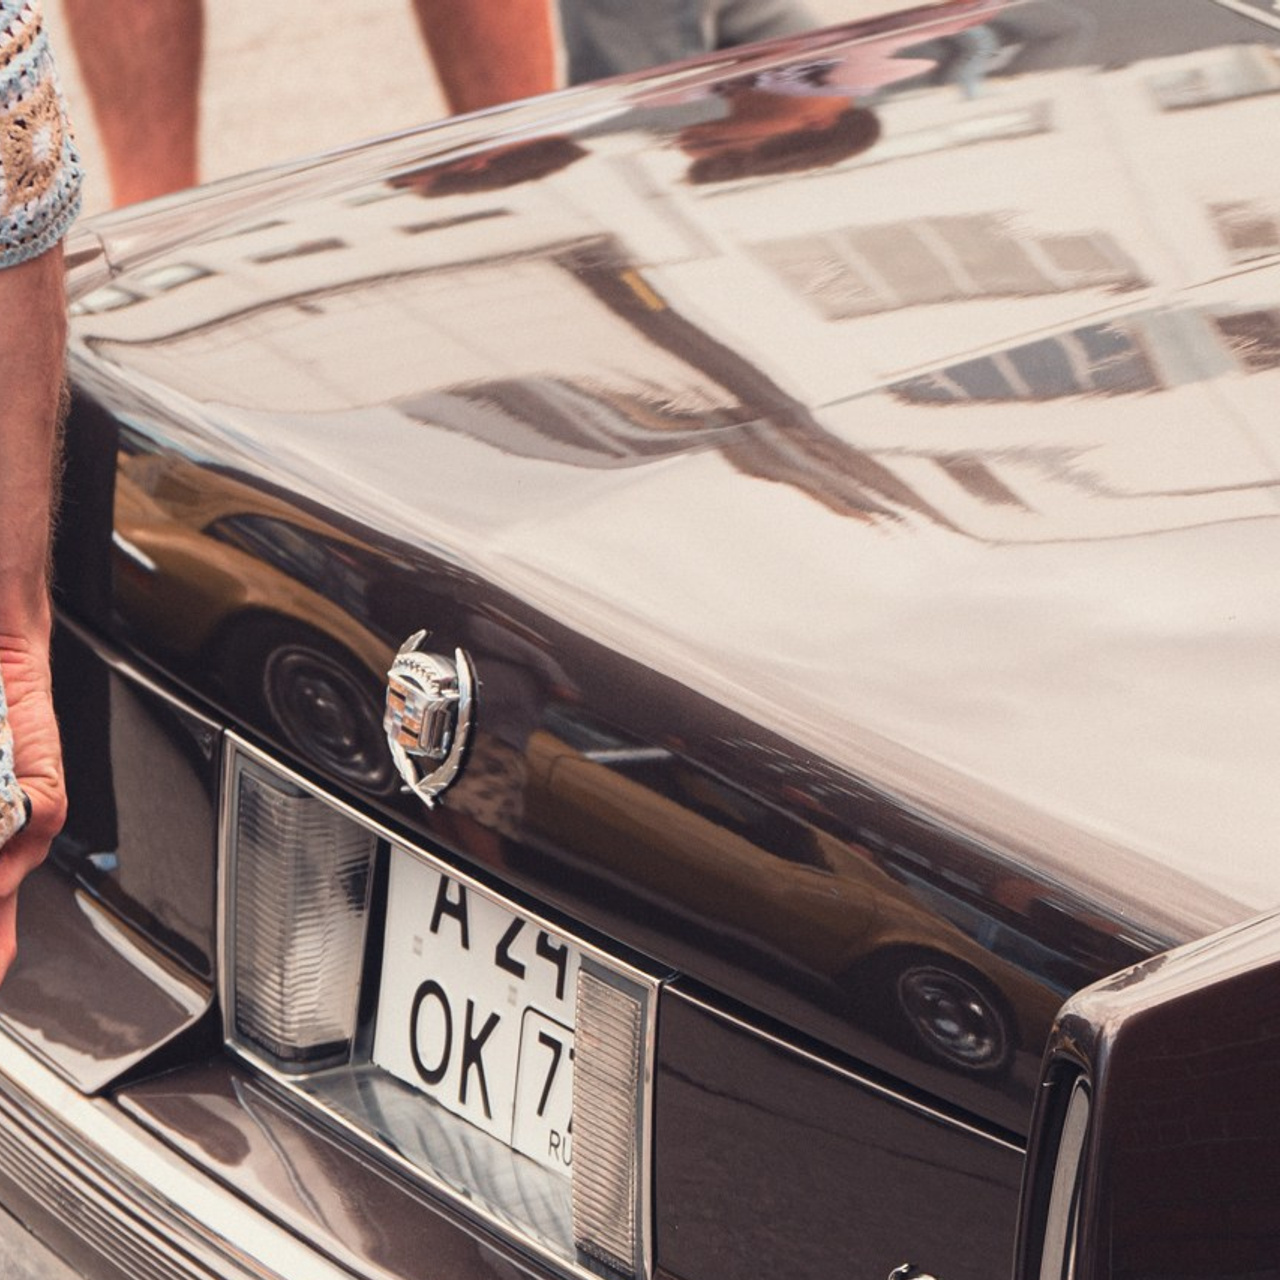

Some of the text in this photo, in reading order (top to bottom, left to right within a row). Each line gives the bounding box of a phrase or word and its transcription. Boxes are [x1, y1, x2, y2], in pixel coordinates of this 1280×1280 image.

[430, 874, 469, 951] A
[410, 979, 575, 1134] OK 7
[548, 1128, 573, 1167] RU
